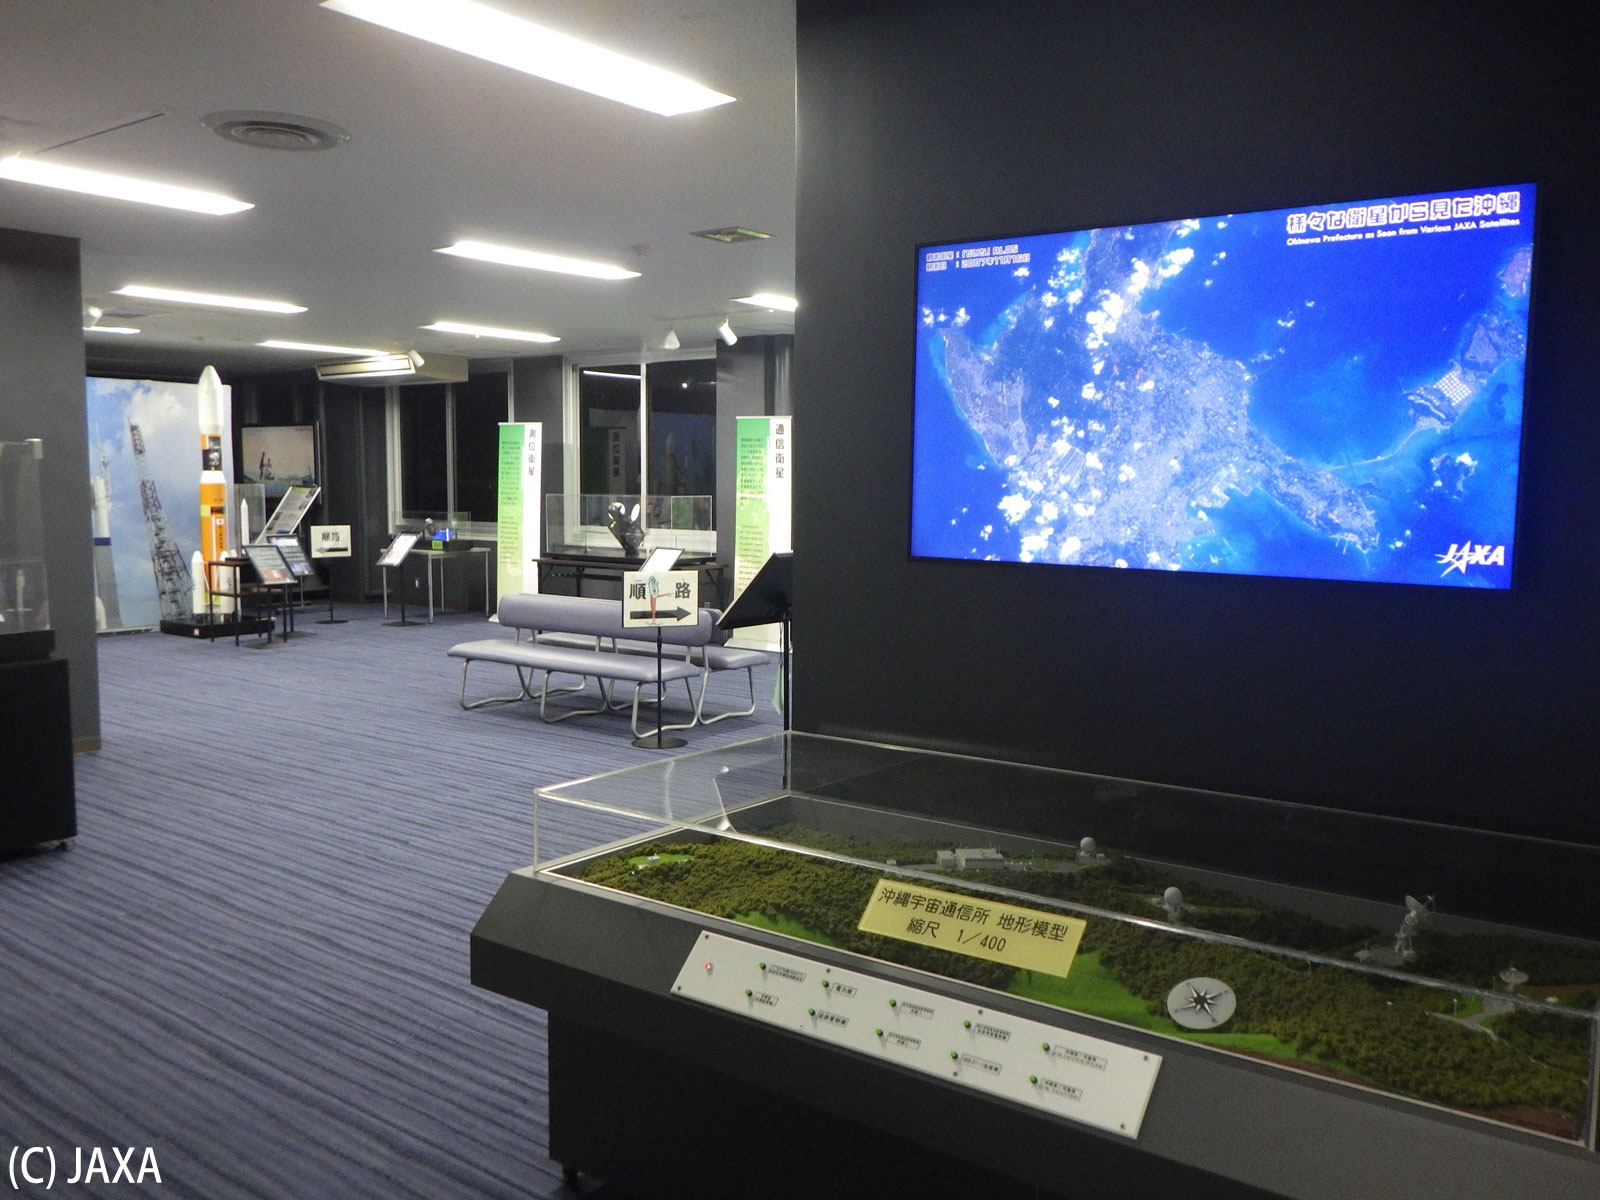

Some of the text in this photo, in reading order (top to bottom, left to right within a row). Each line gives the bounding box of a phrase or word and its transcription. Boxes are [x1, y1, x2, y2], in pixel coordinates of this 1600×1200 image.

[1286, 191, 1520, 234] 様々な衛星から見た沖縄
[1286, 217, 1520, 246] Okinawa Prefecture as Seen from Various JAXA Satellites
[775, 423, 785, 479] 通信衛星
[1435, 540, 1505, 578] JAXA
[878, 887, 1068, 942] 沖縄宇宙通信所 地形模型
[905, 917, 941, 939] 縮尺
